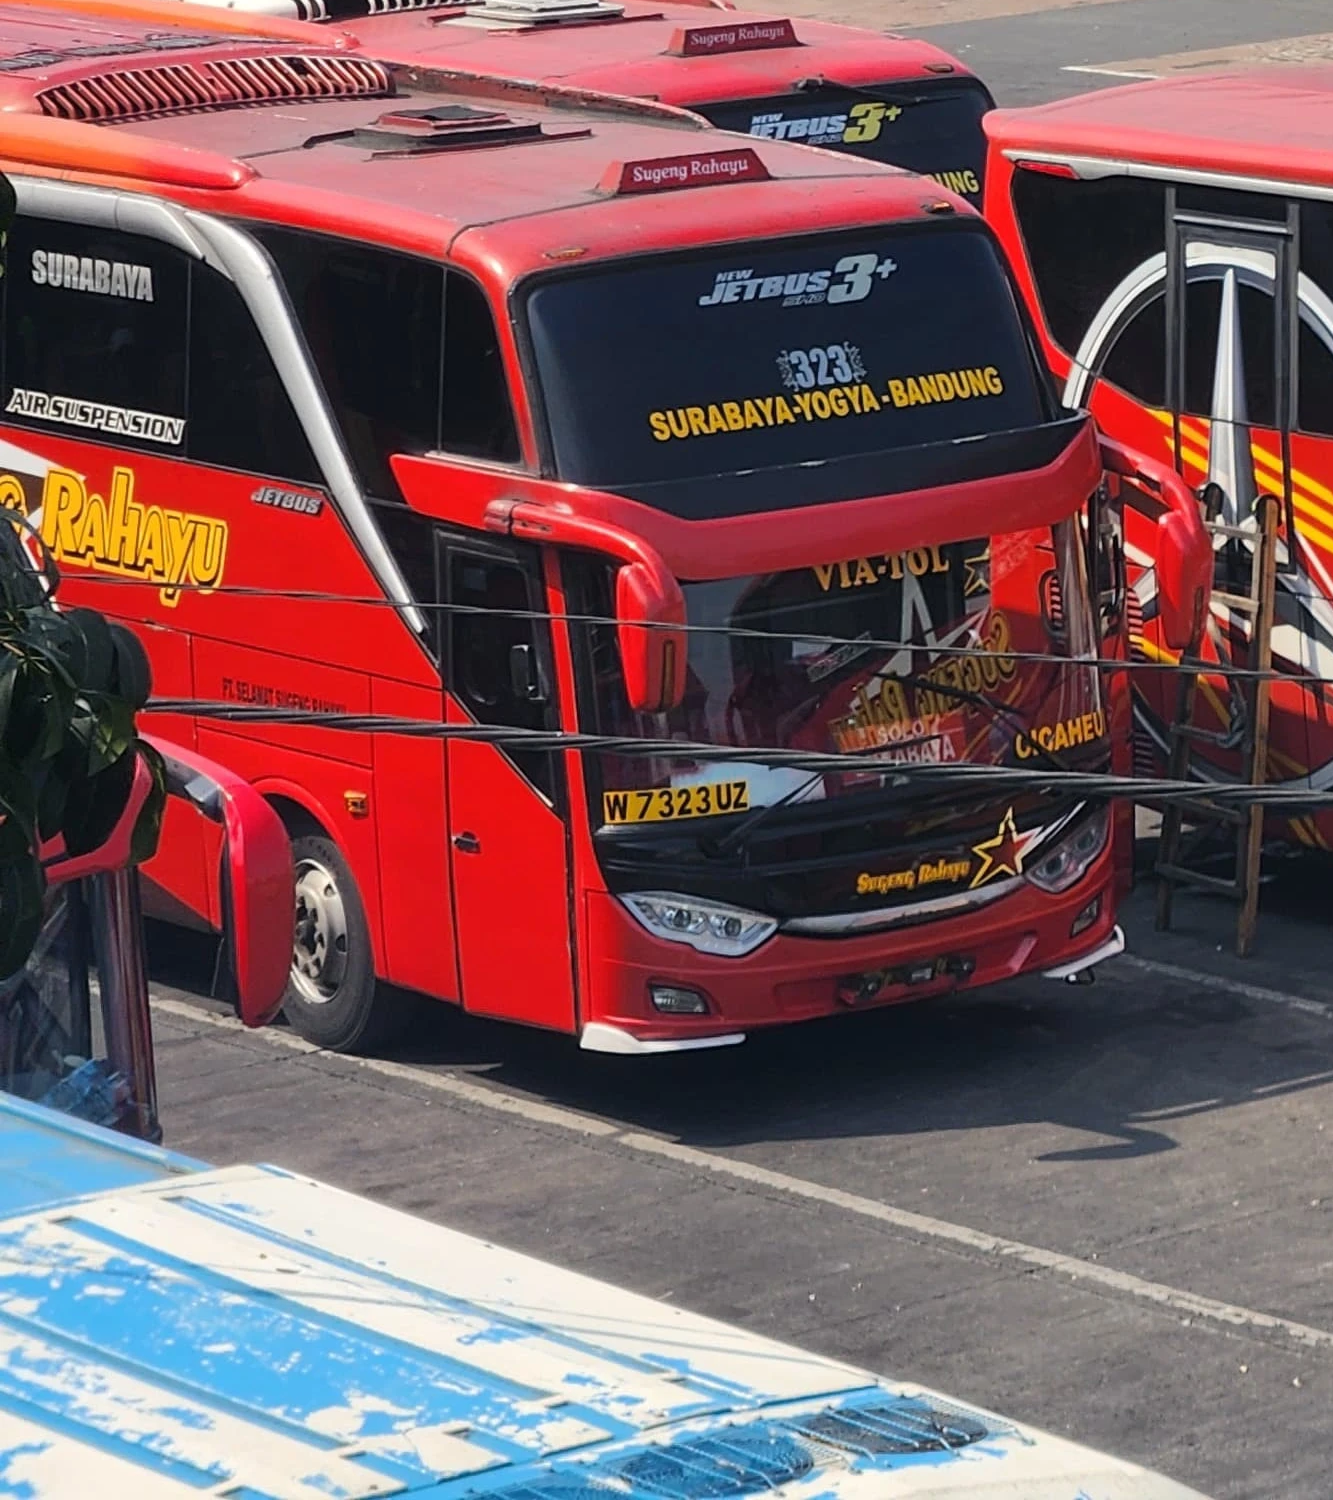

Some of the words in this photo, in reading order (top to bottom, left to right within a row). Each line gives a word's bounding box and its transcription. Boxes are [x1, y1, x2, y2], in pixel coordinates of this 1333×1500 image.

[690, 29, 736, 47] Sugeng
[738, 24, 786, 41] Rahayu
[751, 112, 783, 124] NEW
[632, 163, 688, 185] Sugeng
[690, 157, 749, 179] Rahayu
[31, 250, 154, 302] SURABAYA
[699, 269, 832, 306] JETBUS
[715, 268, 754, 282] NEW
[790, 345, 852, 388] 323
[251, 487, 323, 516] JETBUS
[811, 546, 950, 592] VIA-TOL
[1015, 708, 1106, 759] CICAHEU
[605, 794, 629, 821] W
[637, 785, 711, 819] 7323
[715, 781, 748, 810] UZ
